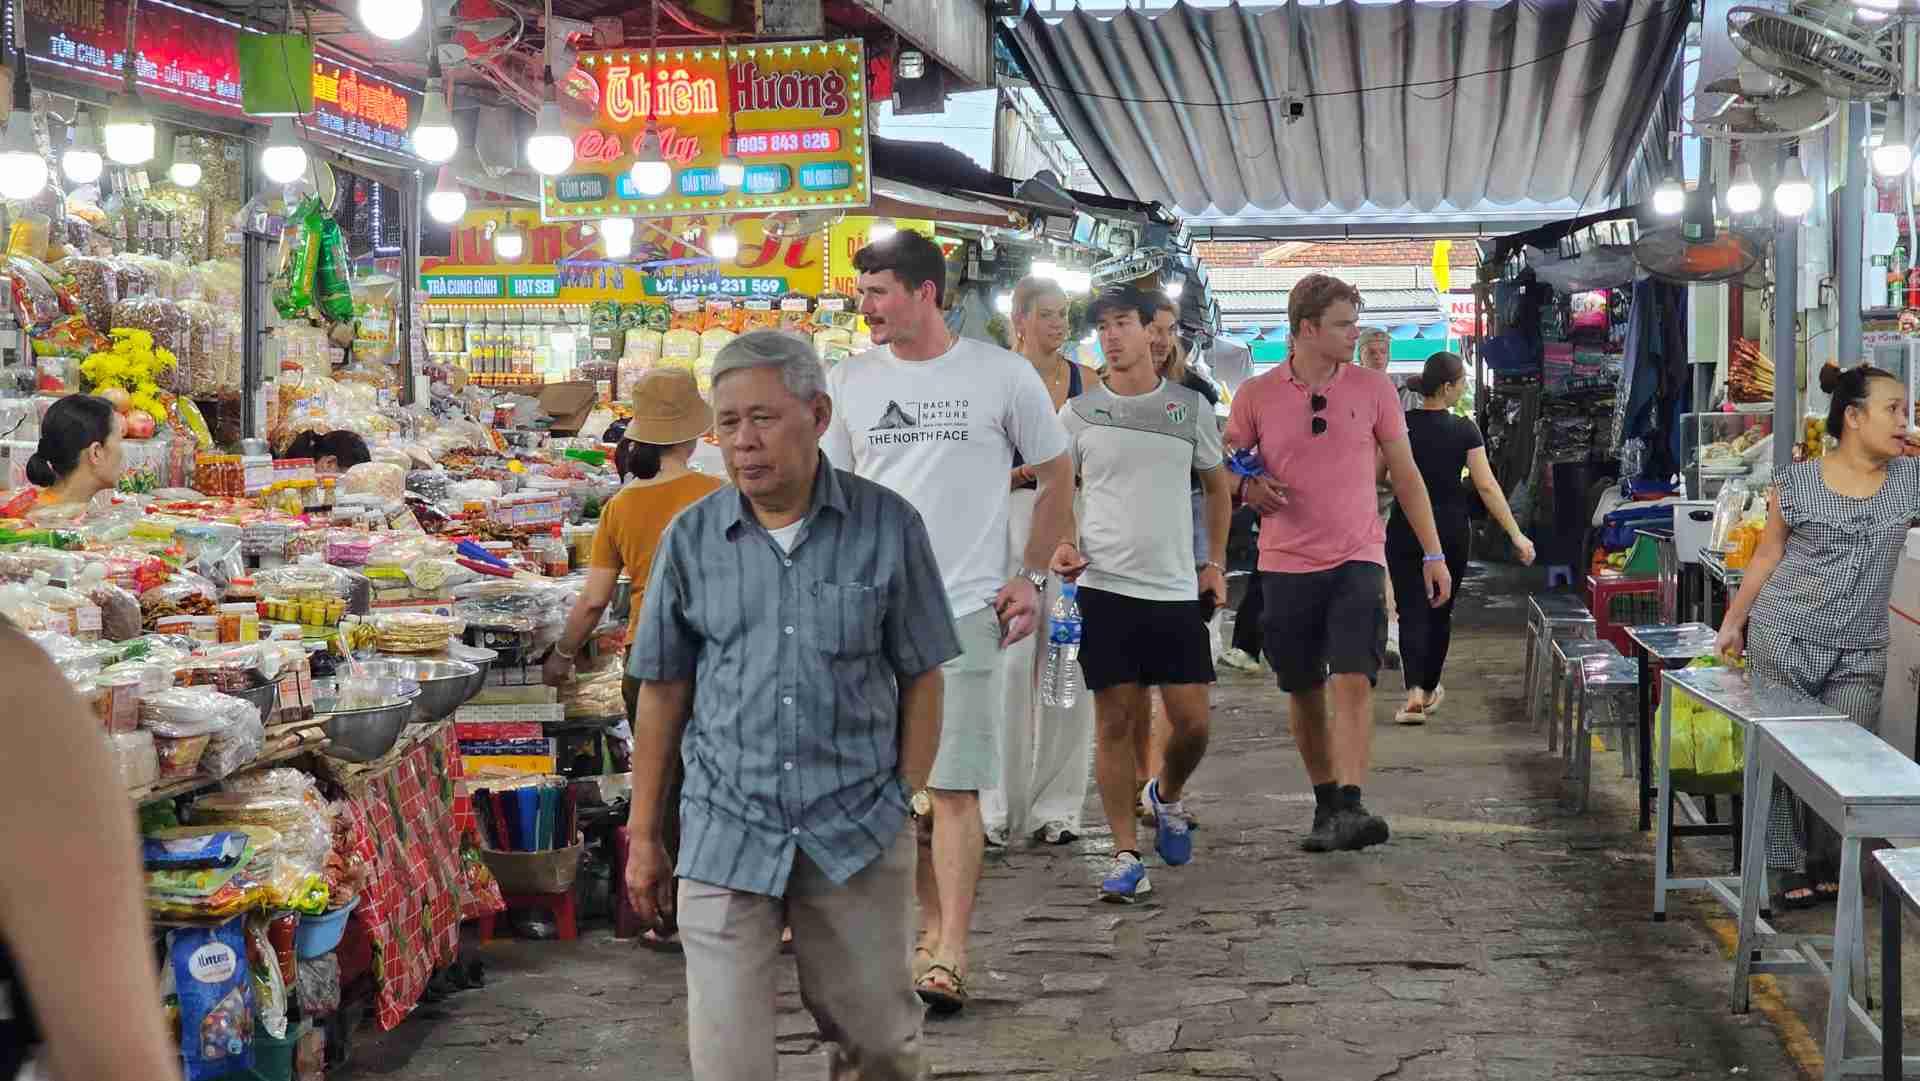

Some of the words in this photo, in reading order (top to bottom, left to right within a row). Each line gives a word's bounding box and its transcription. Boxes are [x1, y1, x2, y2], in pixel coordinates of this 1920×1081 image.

[606, 66, 719, 122] Thiên
[729, 60, 849, 117] Hương
[771, 134, 799, 151] 843
[721, 279, 747, 293] 231
[752, 279, 780, 293] 569
[923, 400, 951, 409] BACK
[956, 400, 969, 408] TO
[923, 411, 969, 419] NATURE
[868, 433, 891, 445] THE
[893, 431, 933, 443] NORTH
[936, 430, 969, 441] FACE
